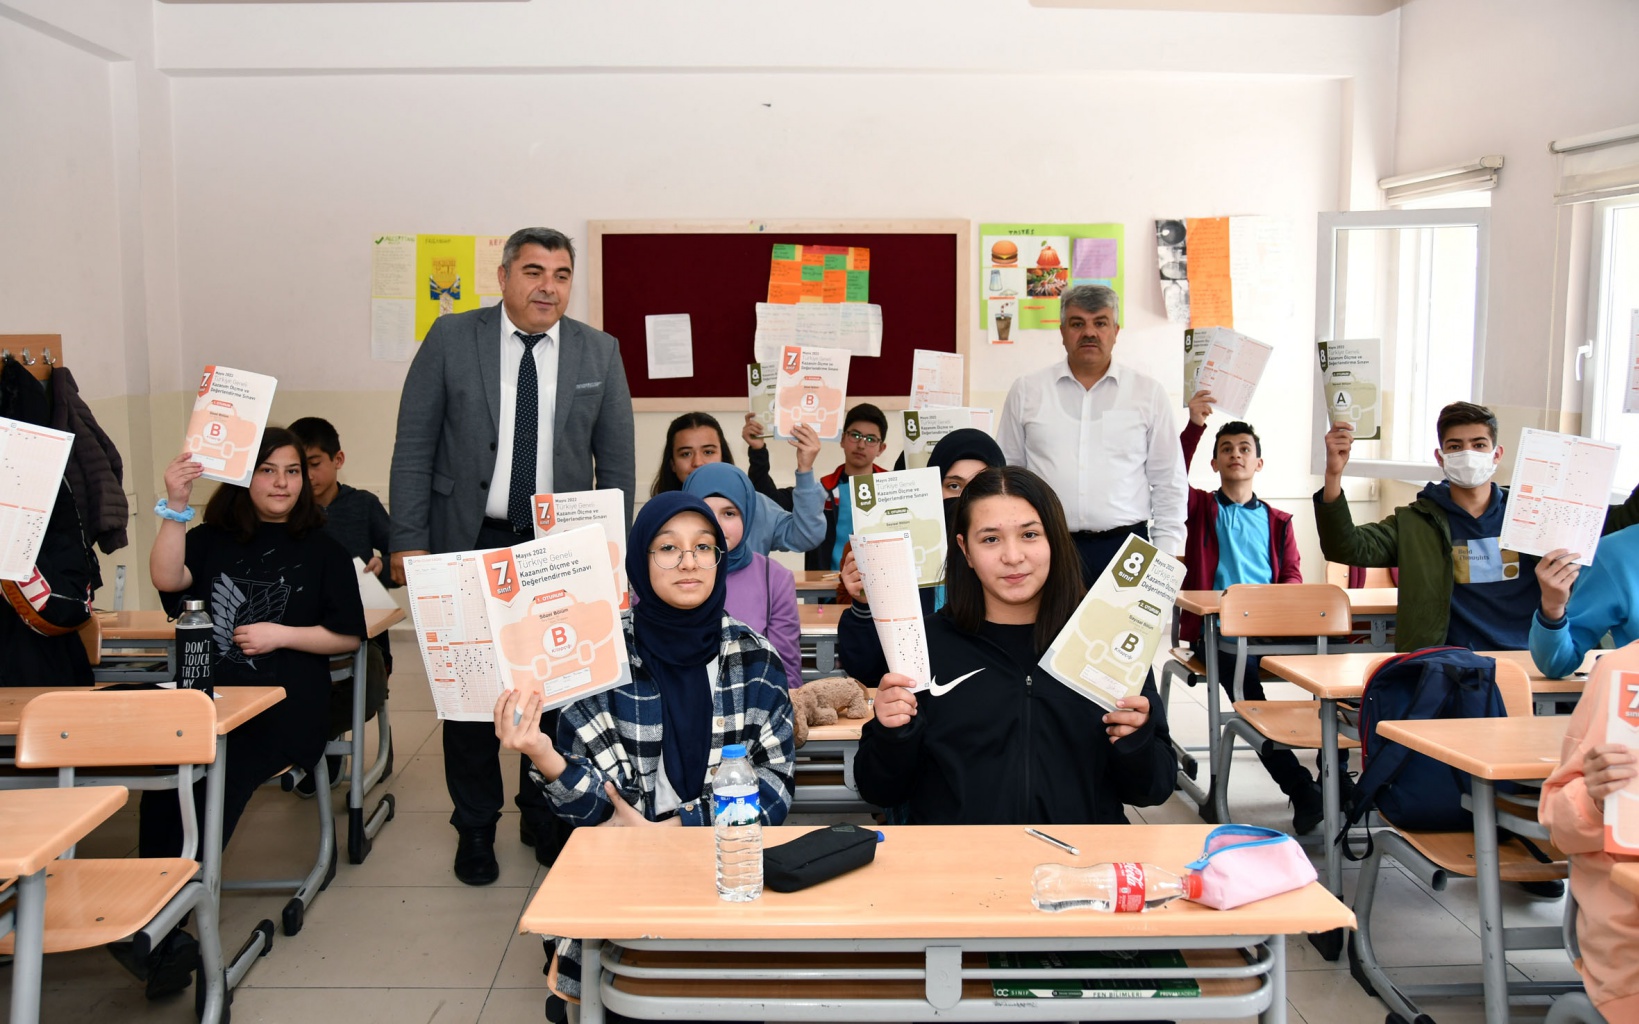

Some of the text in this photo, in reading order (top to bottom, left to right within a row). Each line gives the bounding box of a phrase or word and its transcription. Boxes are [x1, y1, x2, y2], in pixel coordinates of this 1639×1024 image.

[787, 352, 796, 366] 7.
[806, 395, 814, 405] B
[1336, 392, 1346, 404] A
[210, 424, 221, 436] B
[858, 483, 872, 500] 8.
[538, 502, 550, 519] 7.
[533, 548, 546, 556] 2022
[518, 551, 572, 569] Türkiye Geneli
[1123, 552, 1144, 576] 8.
[491, 560, 512, 586] 7.
[519, 567, 548, 578] Kazanım
[549, 562, 570, 571] Ölçme
[522, 565, 592, 586] Değerlendirme Sınavı
[1146, 574, 1165, 588] Kazanım
[552, 627, 567, 647] B
[1121, 633, 1139, 652] B
[185, 640, 210, 653] DON'T
[184, 654, 209, 666] TOUCH
[182, 666, 210, 678] THIS IS
[183, 679, 194, 689] MY
